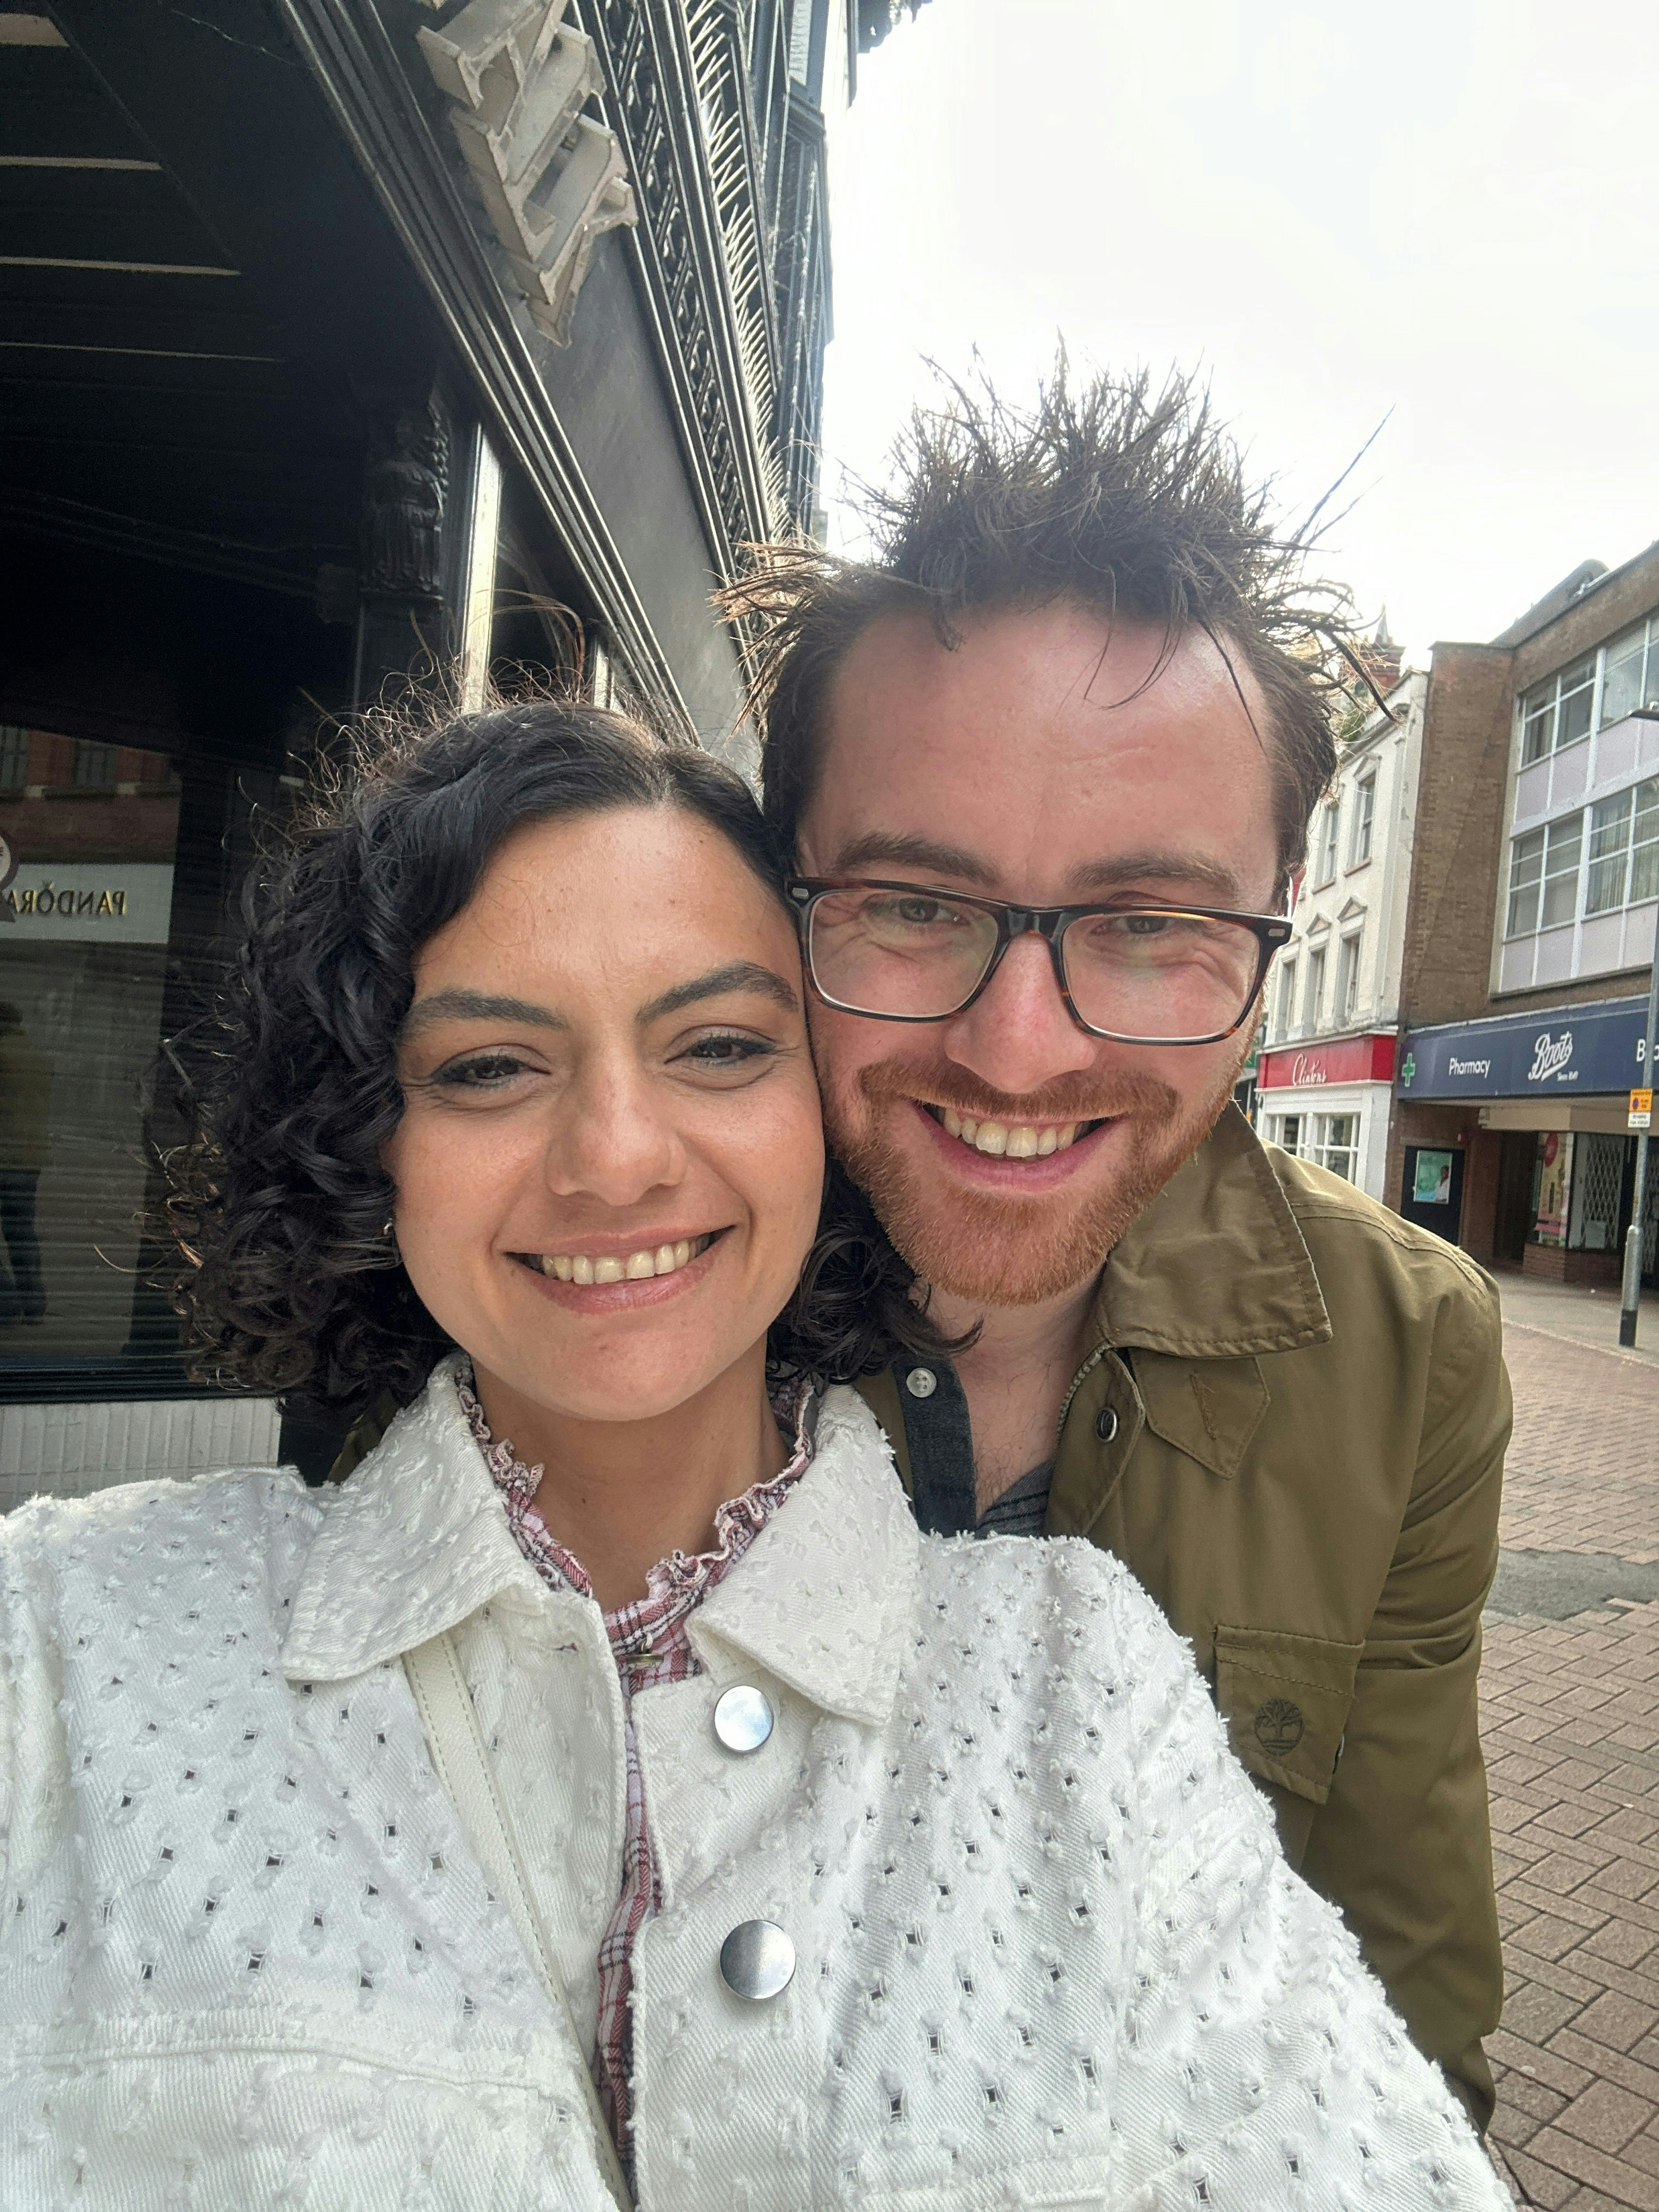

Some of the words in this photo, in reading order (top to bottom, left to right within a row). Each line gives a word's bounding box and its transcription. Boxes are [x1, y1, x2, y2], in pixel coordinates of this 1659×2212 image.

[1292, 1053, 1327, 1086] Clintons
[1449, 1057, 1491, 1079] Pharmacy
[1528, 1030, 1573, 1082] Boots
